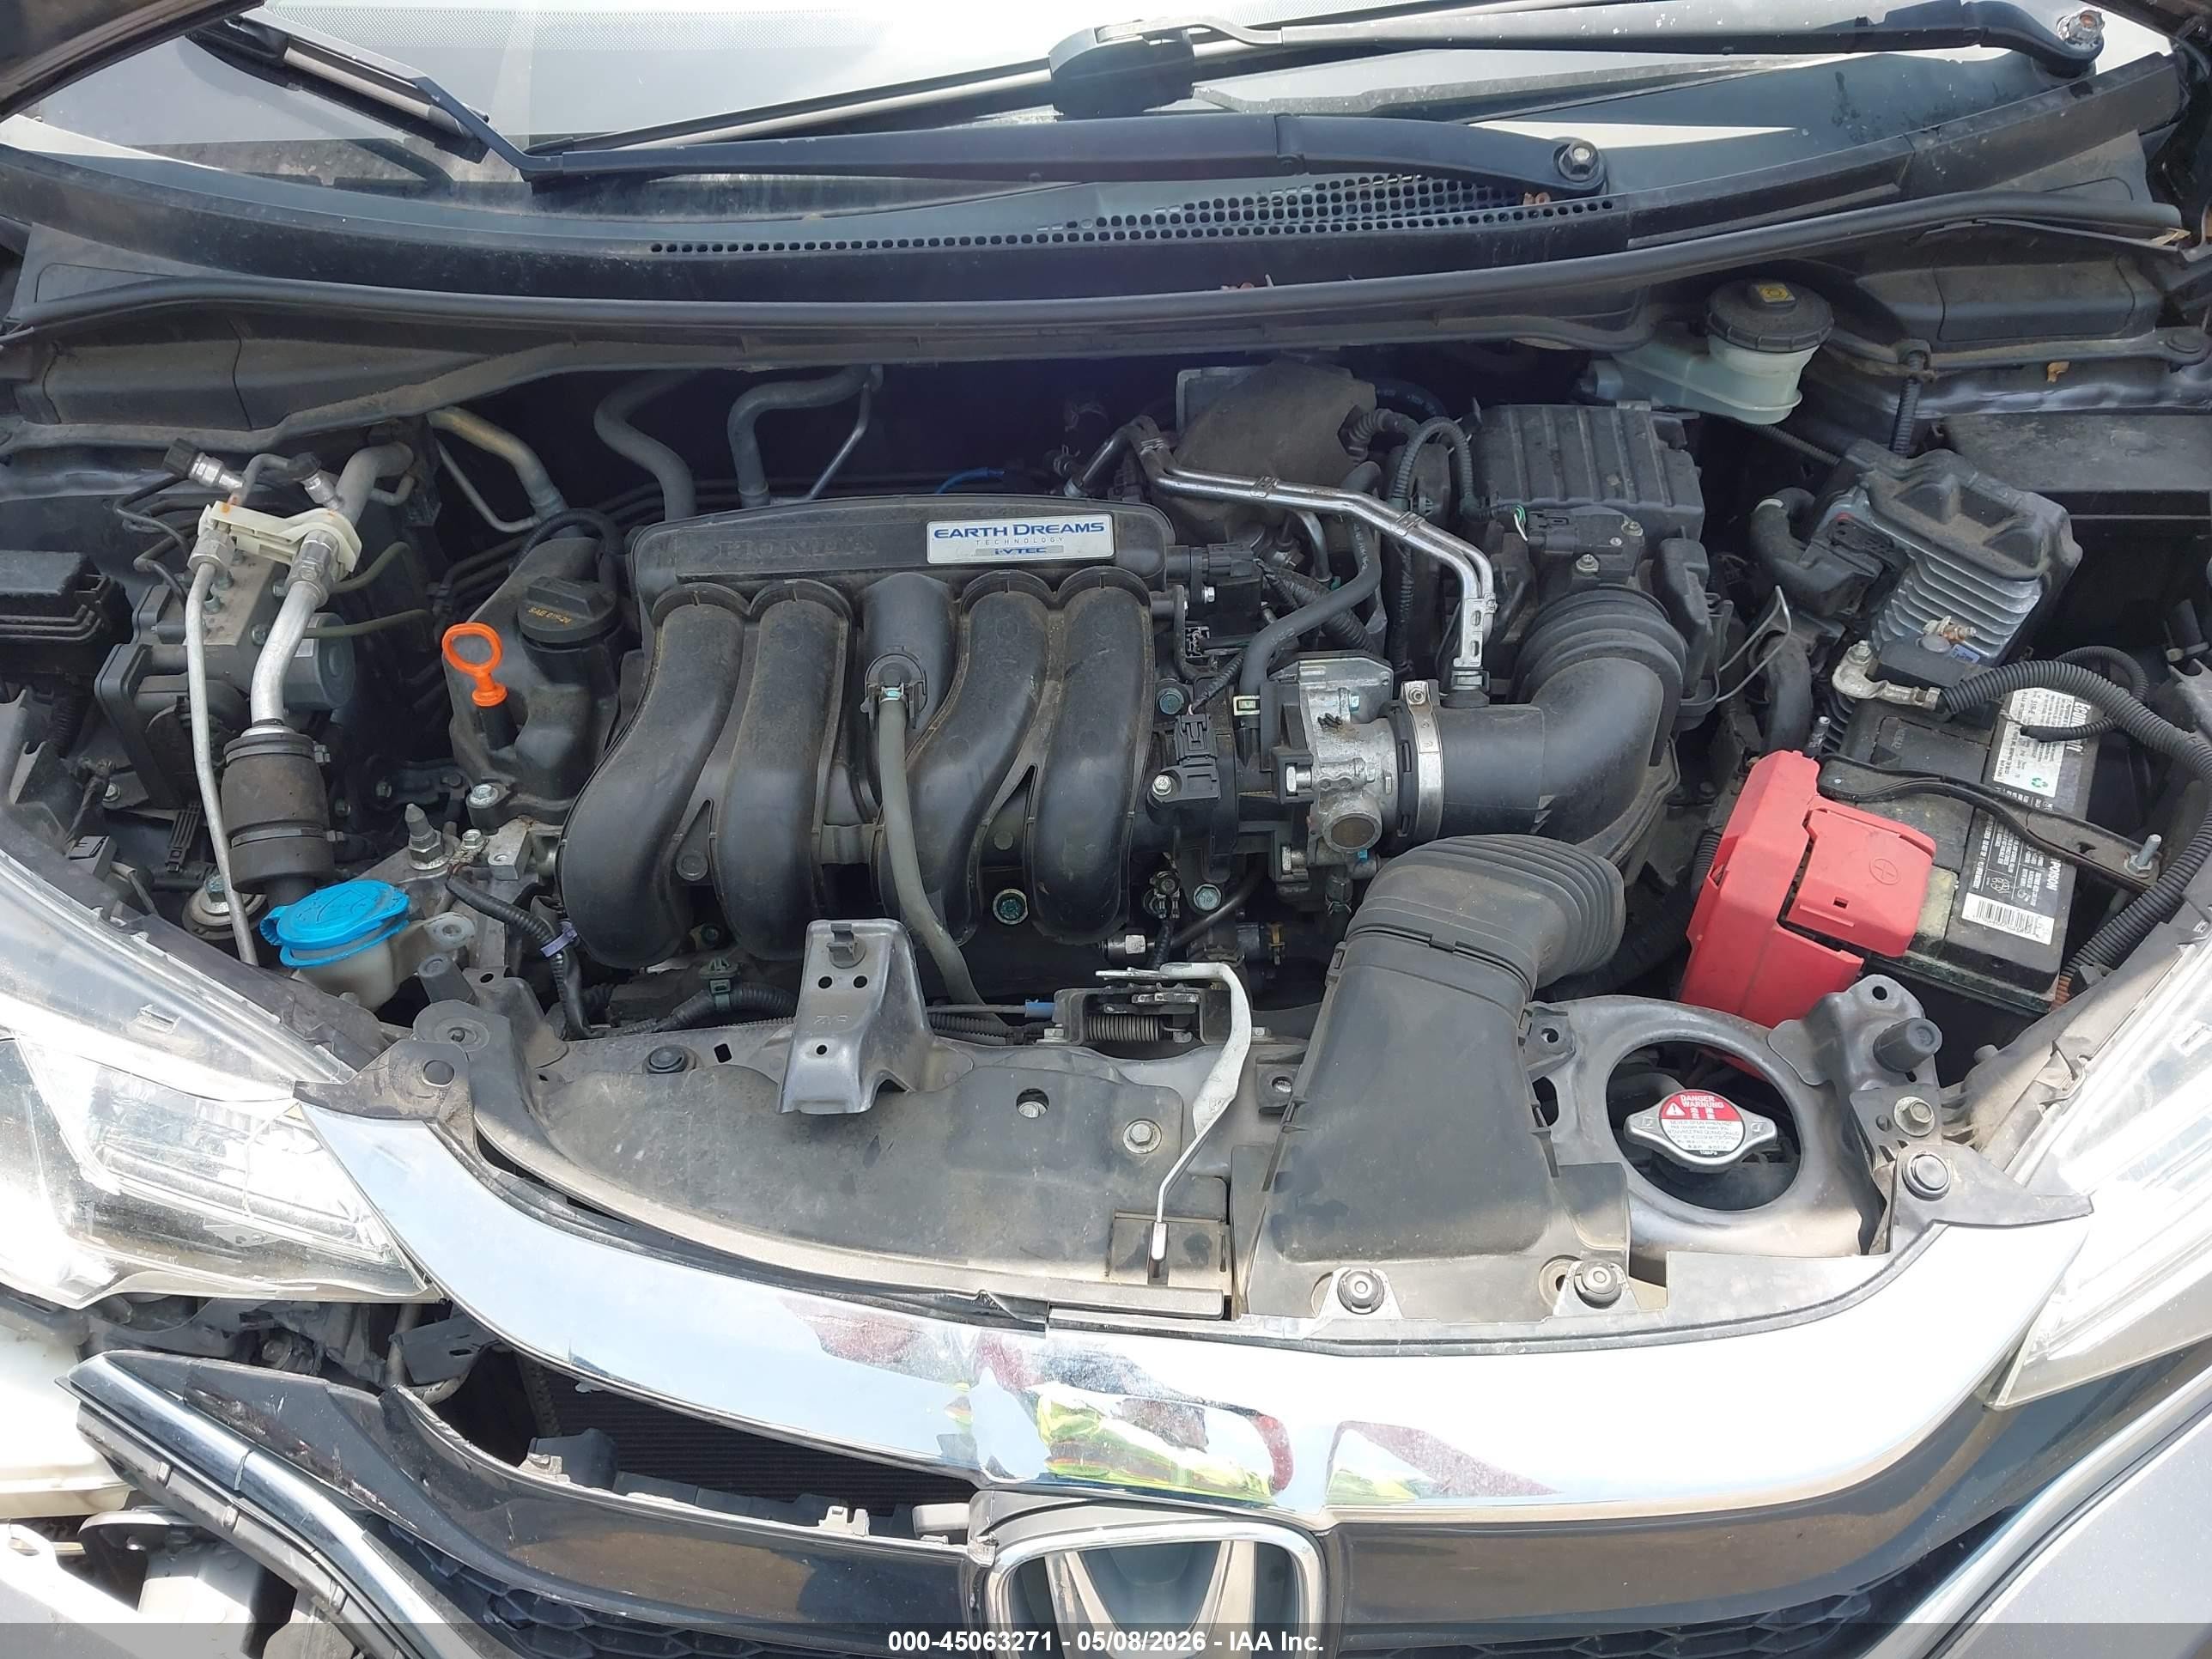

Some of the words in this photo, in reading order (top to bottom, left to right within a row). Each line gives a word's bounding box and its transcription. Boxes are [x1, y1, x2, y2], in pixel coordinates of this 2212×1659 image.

[934, 526, 1007, 538] EARTH
[1013, 522, 1104, 536] DREAMS
[975, 537, 1064, 545] TECHNOLOGY
